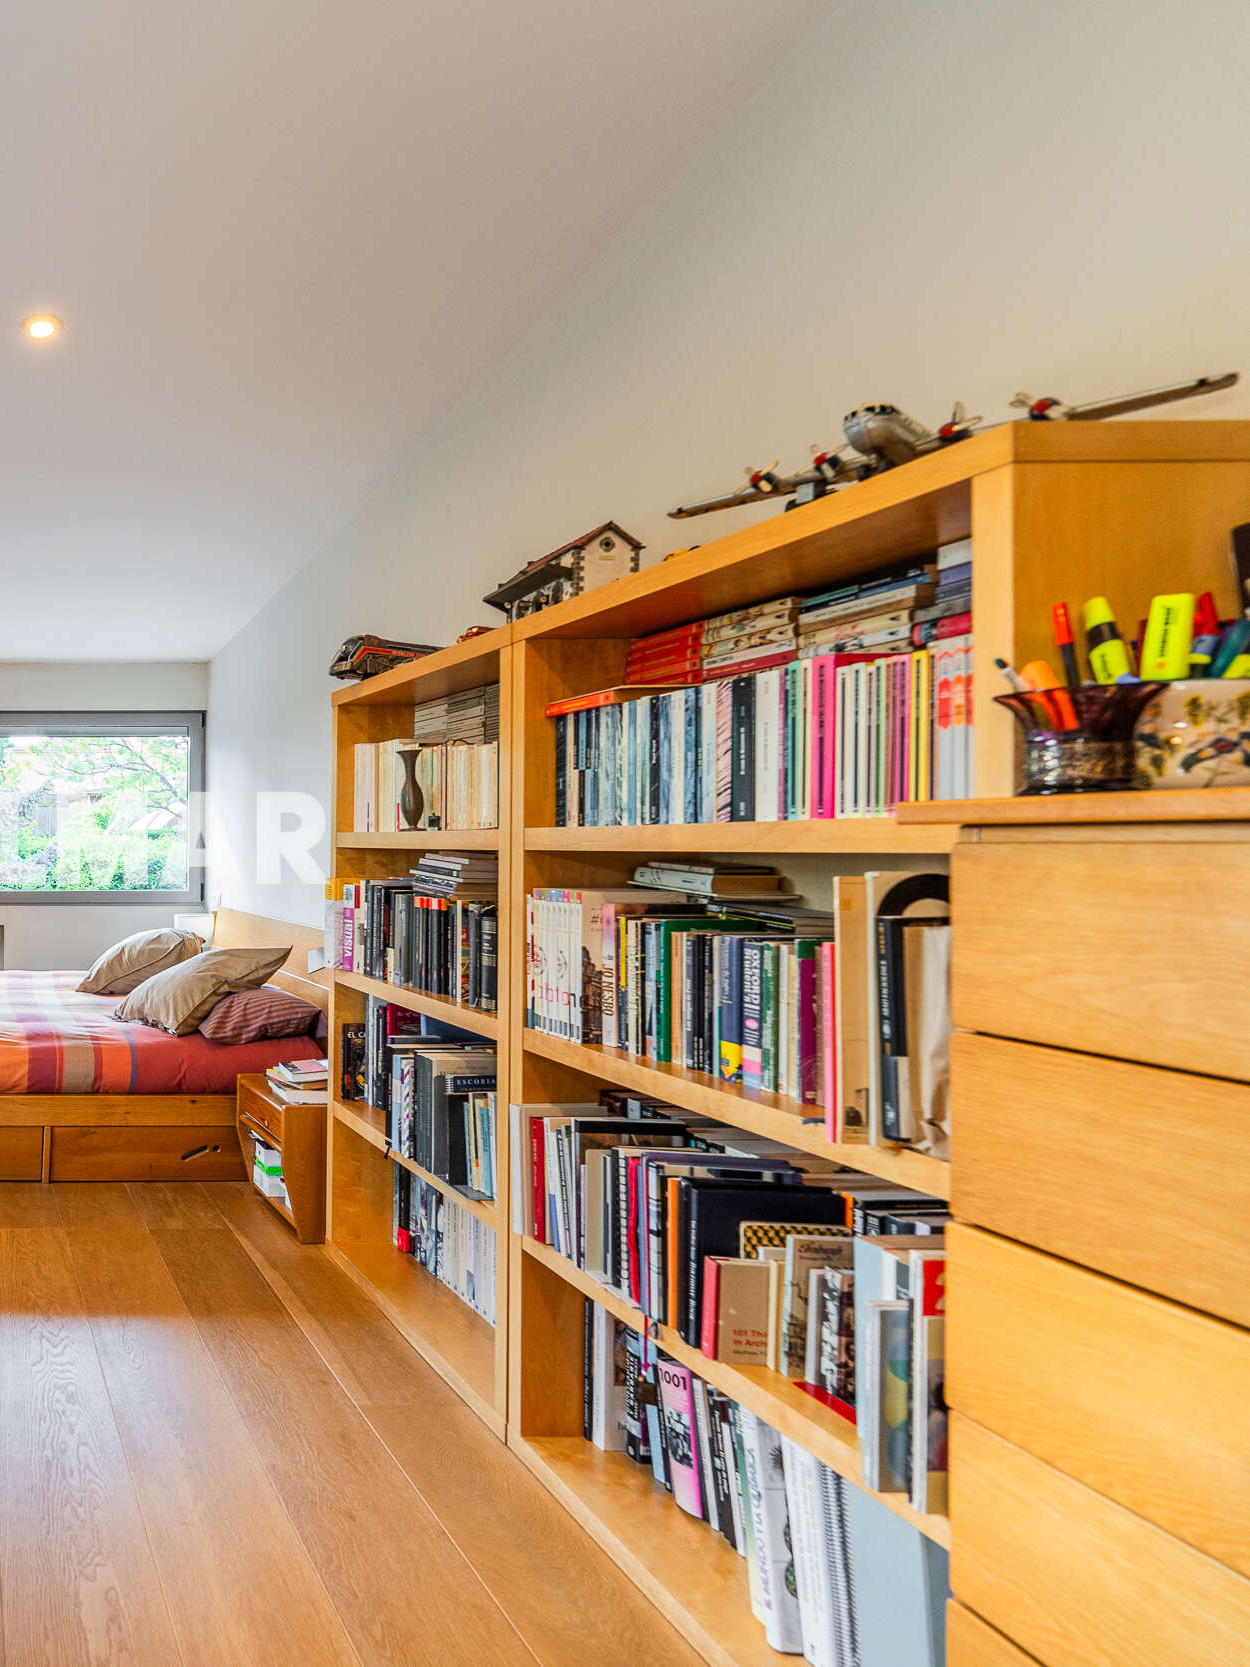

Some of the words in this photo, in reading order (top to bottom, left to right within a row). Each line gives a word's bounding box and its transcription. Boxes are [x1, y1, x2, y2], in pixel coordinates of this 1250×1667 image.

[601, 962, 614, 979] JO
[750, 948, 761, 1005] OXFORD
[659, 1366, 688, 1391] 1001
